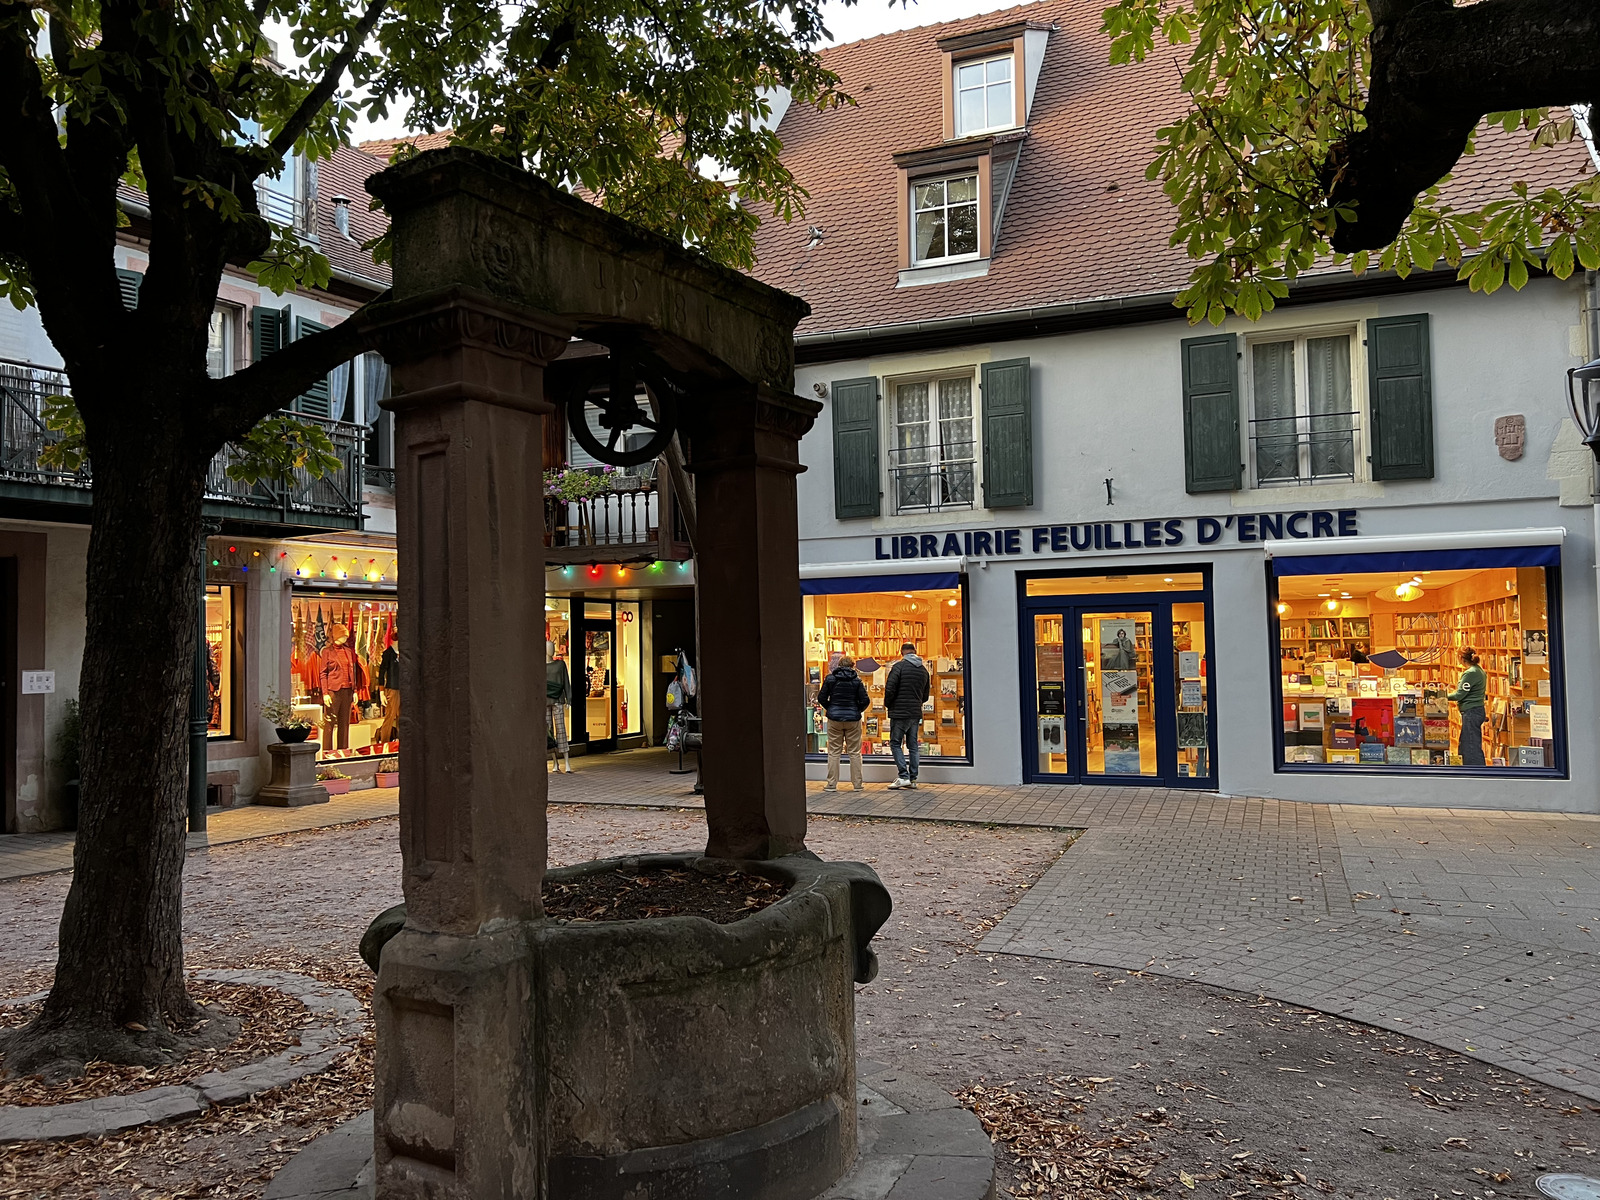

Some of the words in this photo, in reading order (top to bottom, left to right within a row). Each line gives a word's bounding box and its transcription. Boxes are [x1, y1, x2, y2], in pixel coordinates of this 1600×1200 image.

[876, 529, 1021, 561] LIBRAIRIE
[1032, 519, 1184, 554] FEUILLES
[1197, 510, 1358, 544] D'ENCRE
